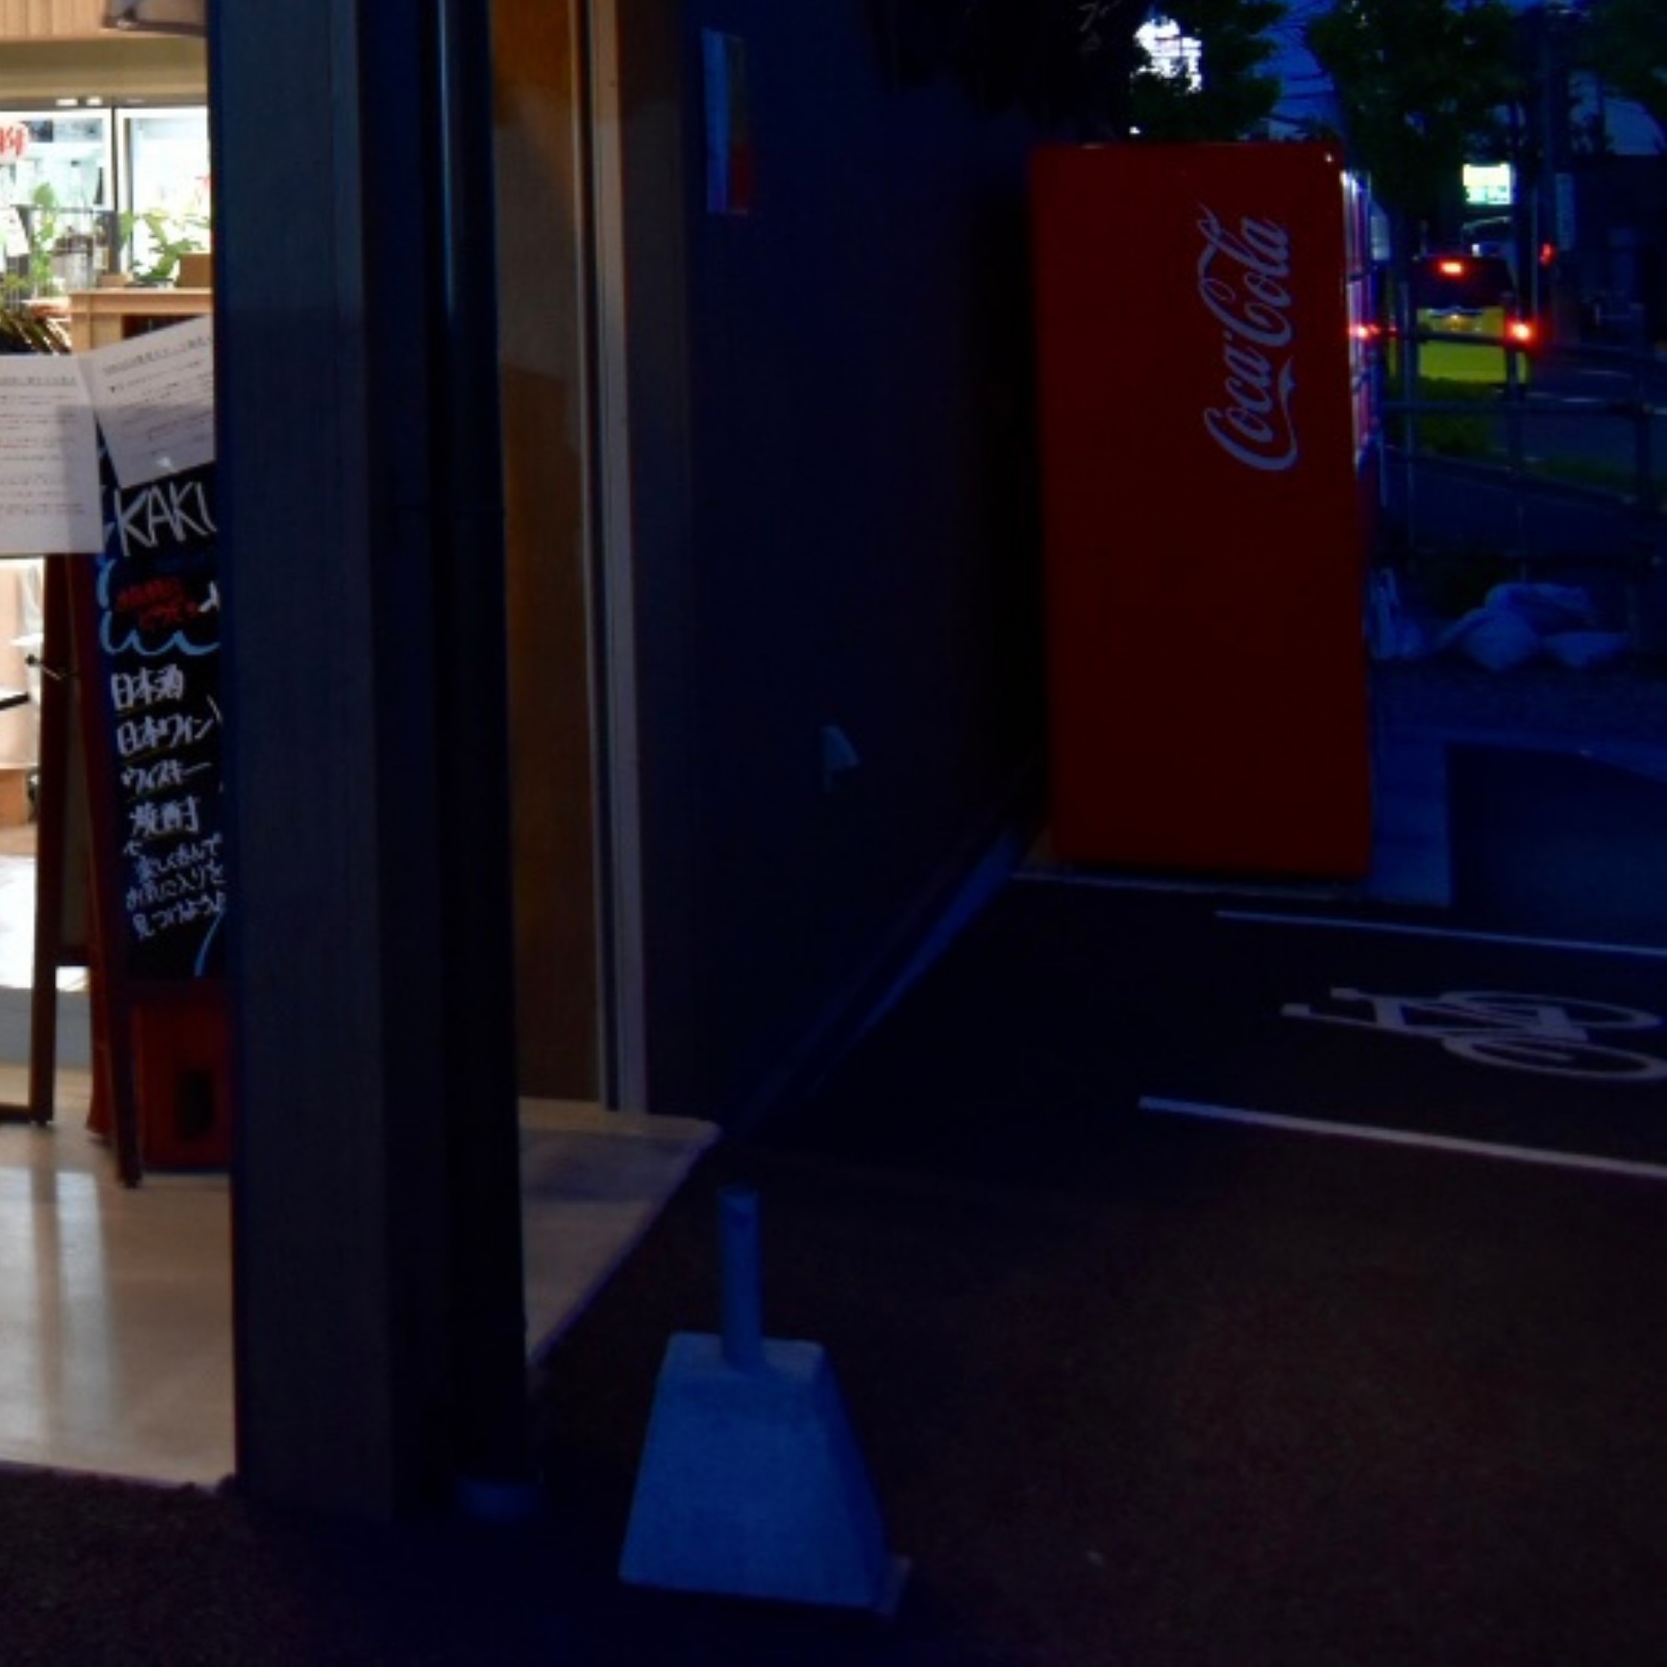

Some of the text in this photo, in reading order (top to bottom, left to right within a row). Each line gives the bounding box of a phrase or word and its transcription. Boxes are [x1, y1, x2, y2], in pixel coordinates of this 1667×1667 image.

[1196, 201, 1301, 472] Coca-Cola
[110, 663, 185, 711] 日本酒
